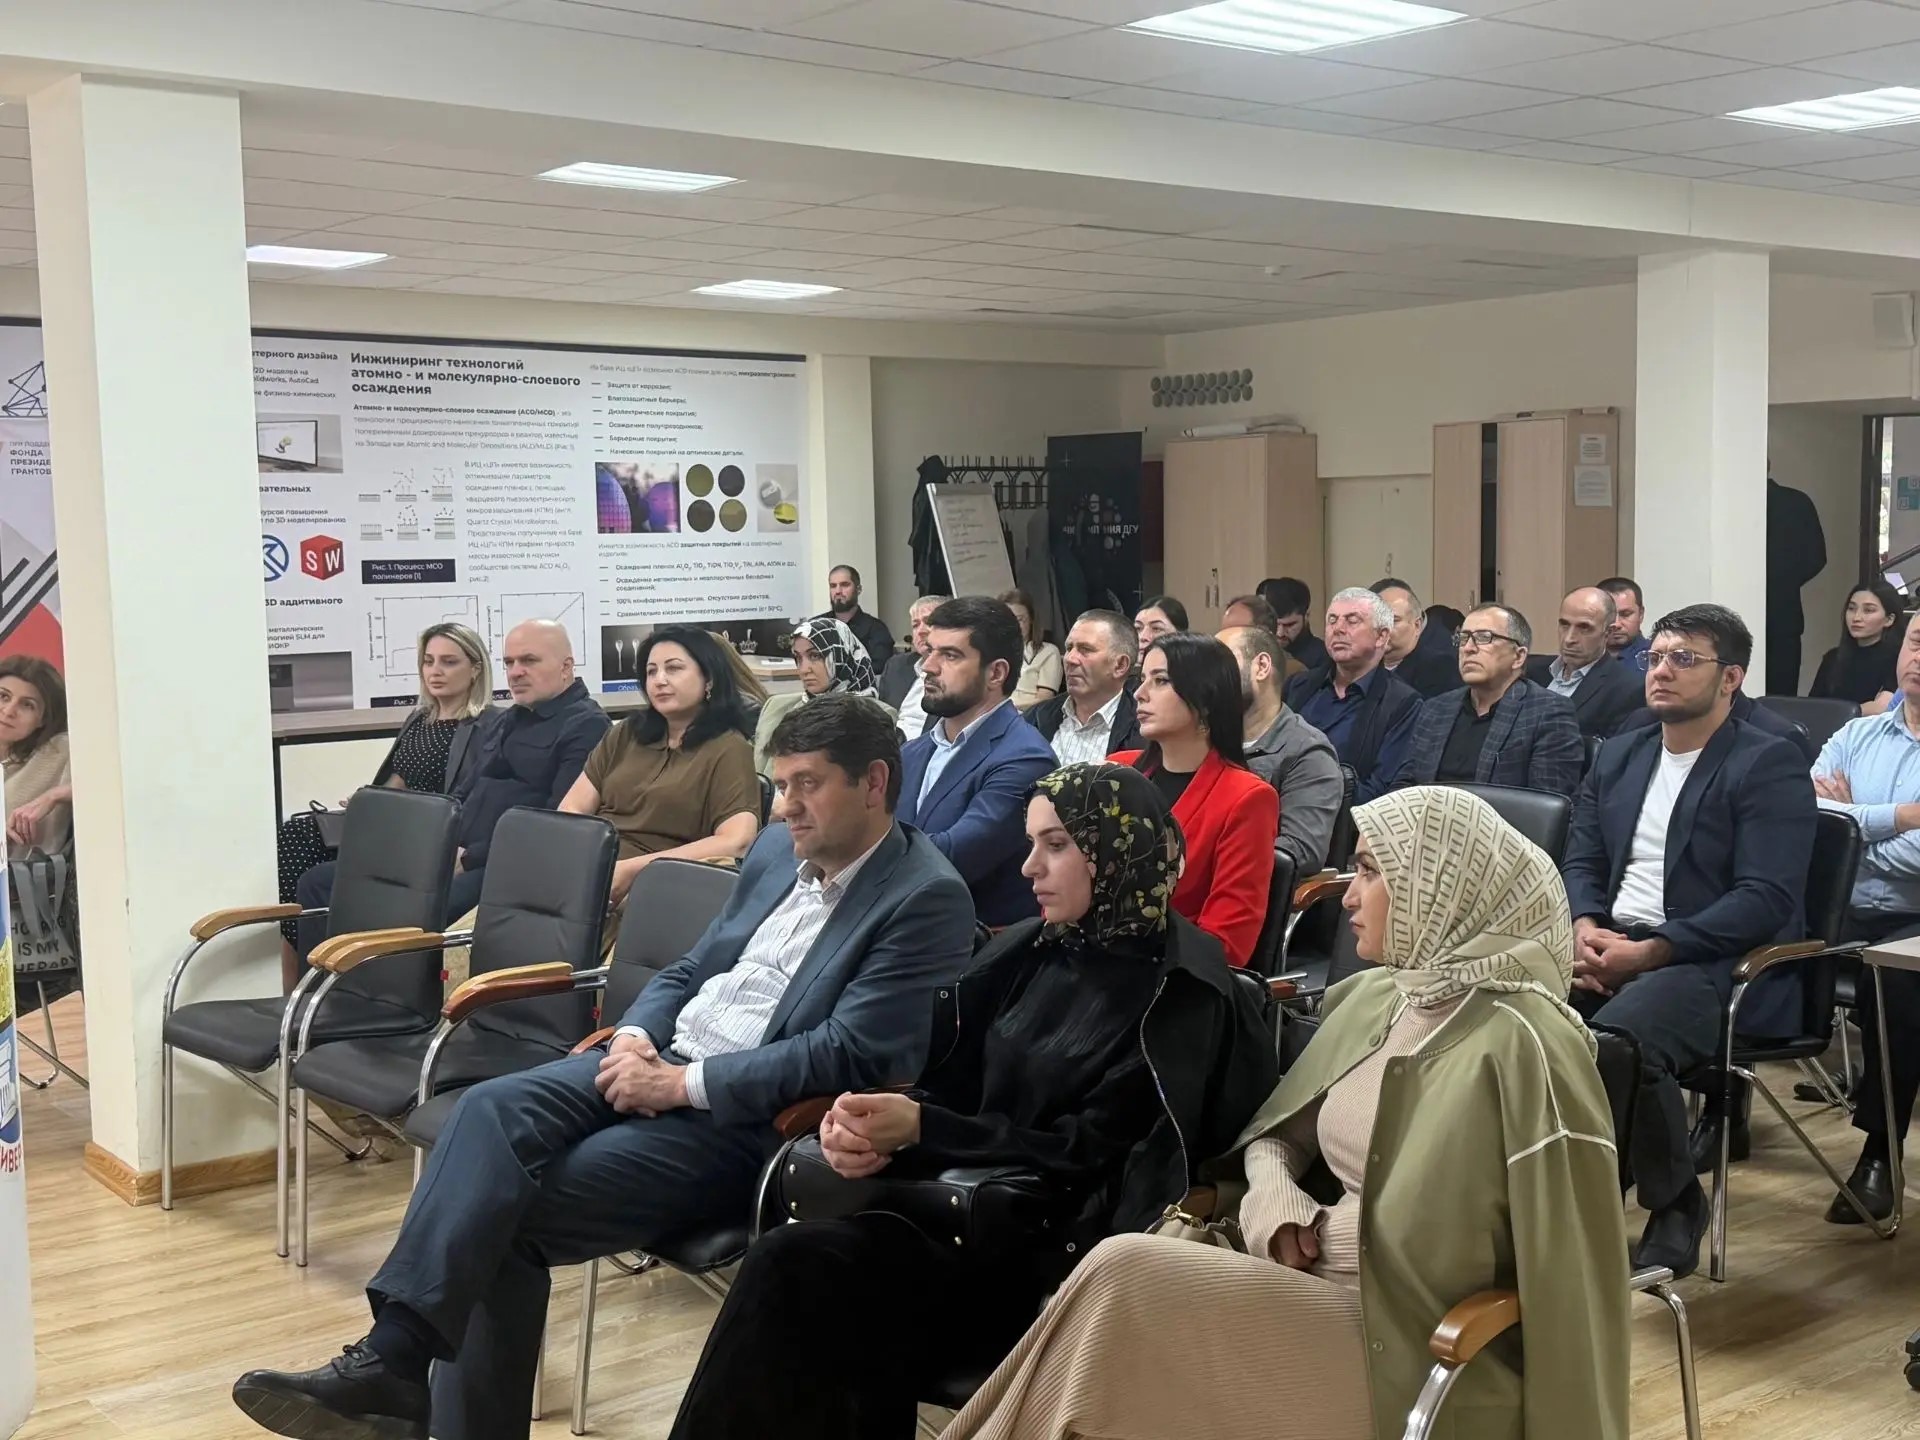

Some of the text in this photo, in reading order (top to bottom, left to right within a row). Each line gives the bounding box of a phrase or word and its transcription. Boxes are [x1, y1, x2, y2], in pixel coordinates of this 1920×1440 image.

[297, 352, 338, 360] дизайна
[351, 353, 524, 370] Инжиниринг технологий
[351, 369, 402, 380] атомно
[415, 372, 424, 380] и
[428, 372, 581, 386] молекулярно-слоевого
[352, 384, 432, 394] осаждения
[607, 395, 657, 403] Влагозащитные
[279, 598, 343, 607] аддитивного
[17, 942, 33, 957] IS
